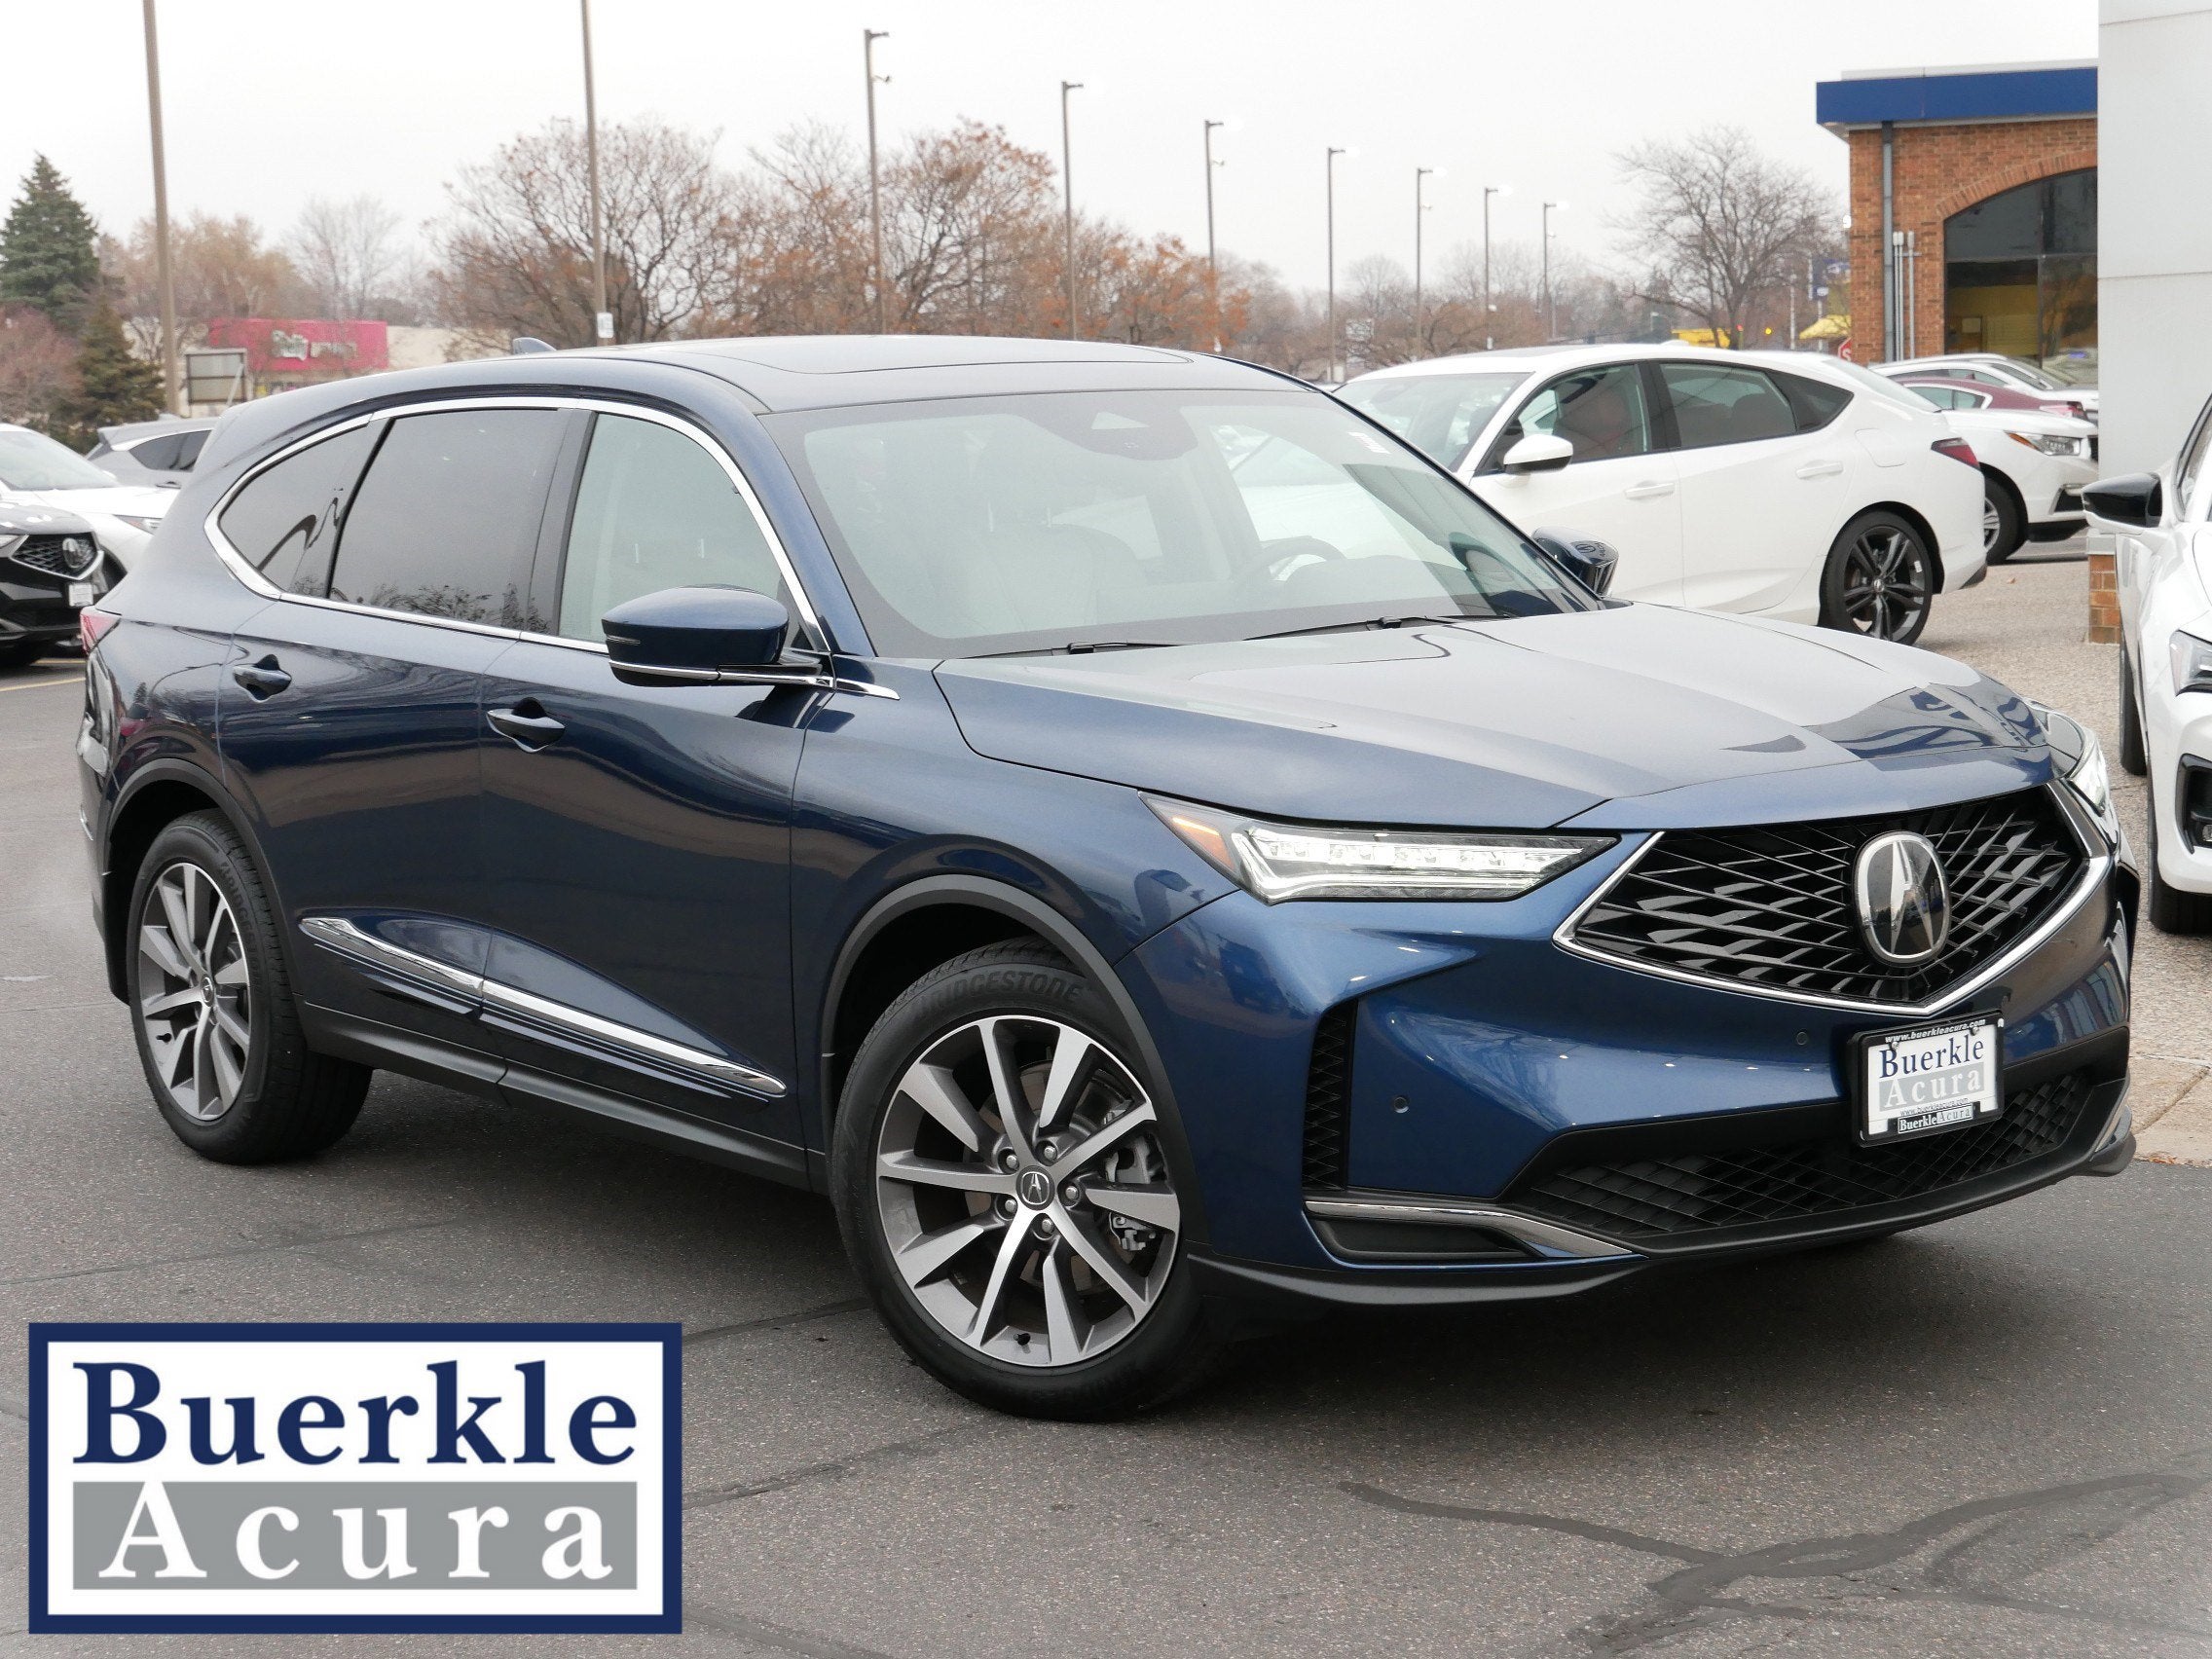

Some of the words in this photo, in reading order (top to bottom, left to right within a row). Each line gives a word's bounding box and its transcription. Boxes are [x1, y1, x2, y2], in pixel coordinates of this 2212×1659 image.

[1885, 1019, 1985, 1043] www.buerkleacura.com
[1879, 1035, 1983, 1078] Buerkle
[1885, 1069, 1981, 1108] Acura
